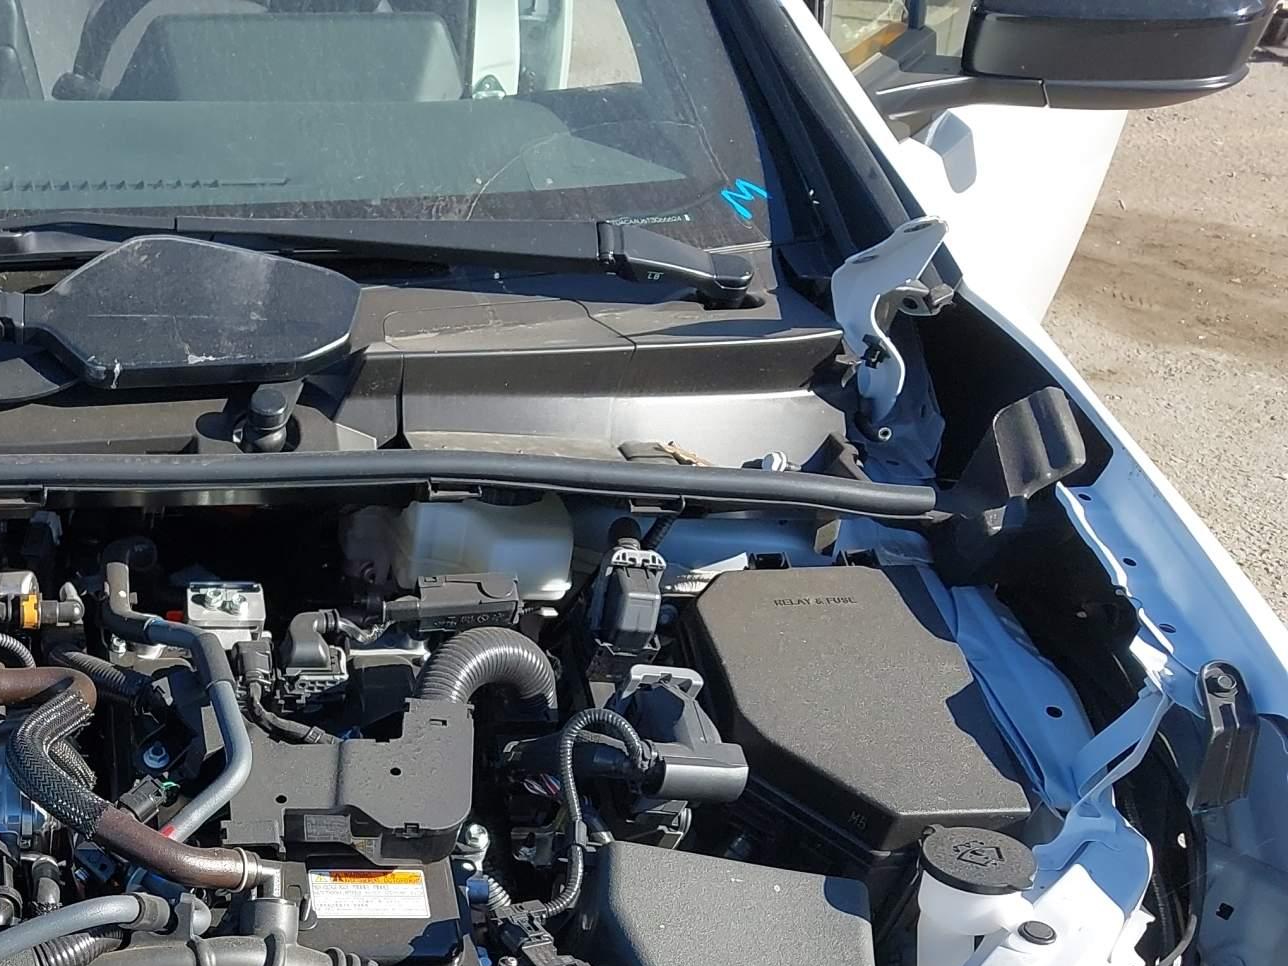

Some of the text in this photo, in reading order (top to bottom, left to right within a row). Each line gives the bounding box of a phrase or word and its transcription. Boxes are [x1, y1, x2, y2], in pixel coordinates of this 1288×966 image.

[721, 179, 768, 220] M
[773, 597, 811, 606] RELAY
[826, 596, 857, 605] FUSE
